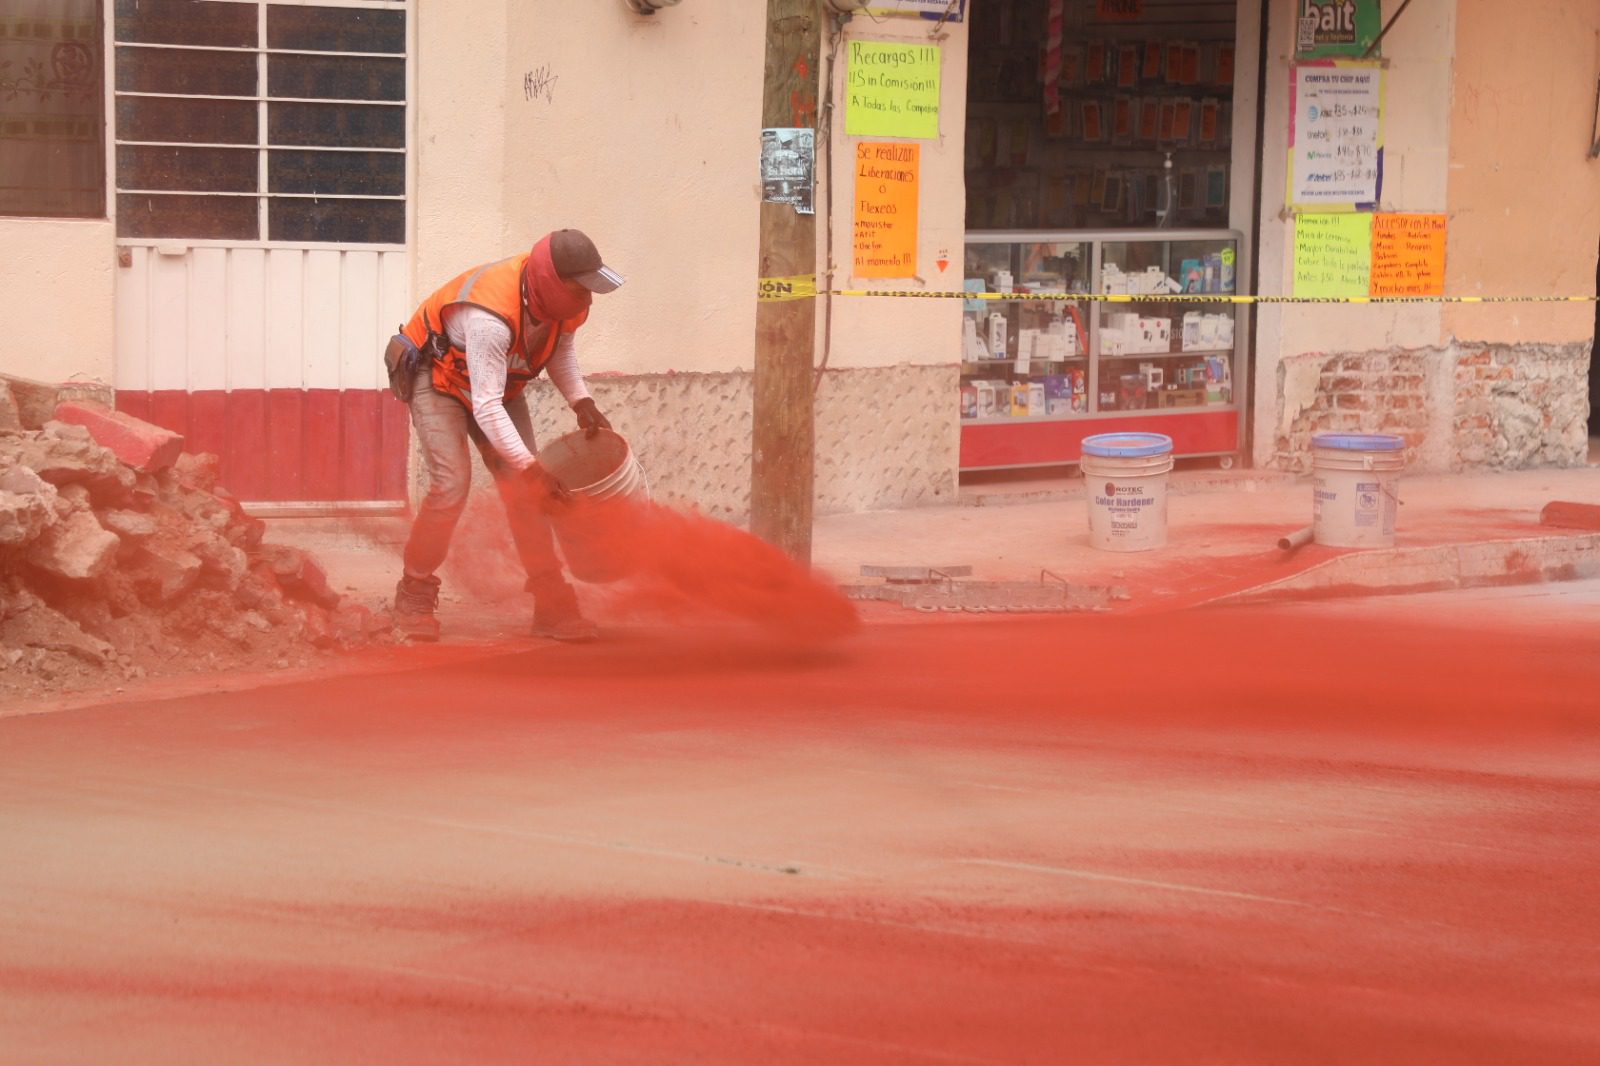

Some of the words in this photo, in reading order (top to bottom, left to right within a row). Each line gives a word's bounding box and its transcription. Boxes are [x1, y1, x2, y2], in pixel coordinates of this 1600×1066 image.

[1305, 0, 1355, 31] bait
[853, 42, 916, 68] Recargas
[852, 95, 860, 107] A
[863, 96, 887, 112] Todas
[889, 100, 901, 114] las
[857, 142, 871, 160] Se
[875, 144, 915, 162] realizan
[859, 165, 914, 183] Liberaciones
[867, 256, 901, 267] momento
[1095, 496, 1115, 507] Color
[1116, 496, 1154, 508] Hardener
